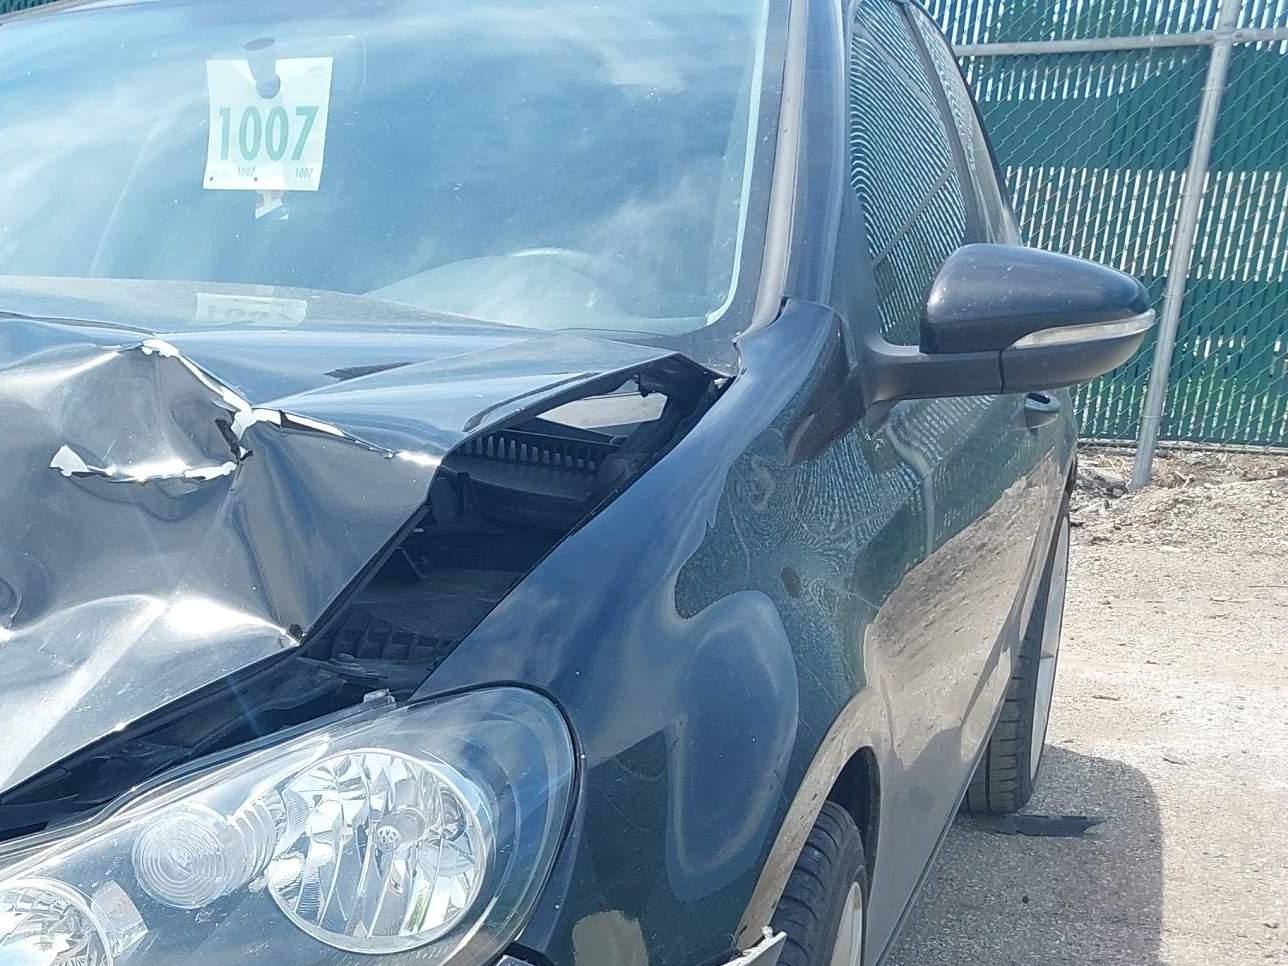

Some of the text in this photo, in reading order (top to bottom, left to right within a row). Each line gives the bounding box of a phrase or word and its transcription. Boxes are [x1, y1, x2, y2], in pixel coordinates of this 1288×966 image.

[218, 106, 319, 161] 1007
[237, 166, 256, 177] 1007
[295, 168, 314, 178] 1007
